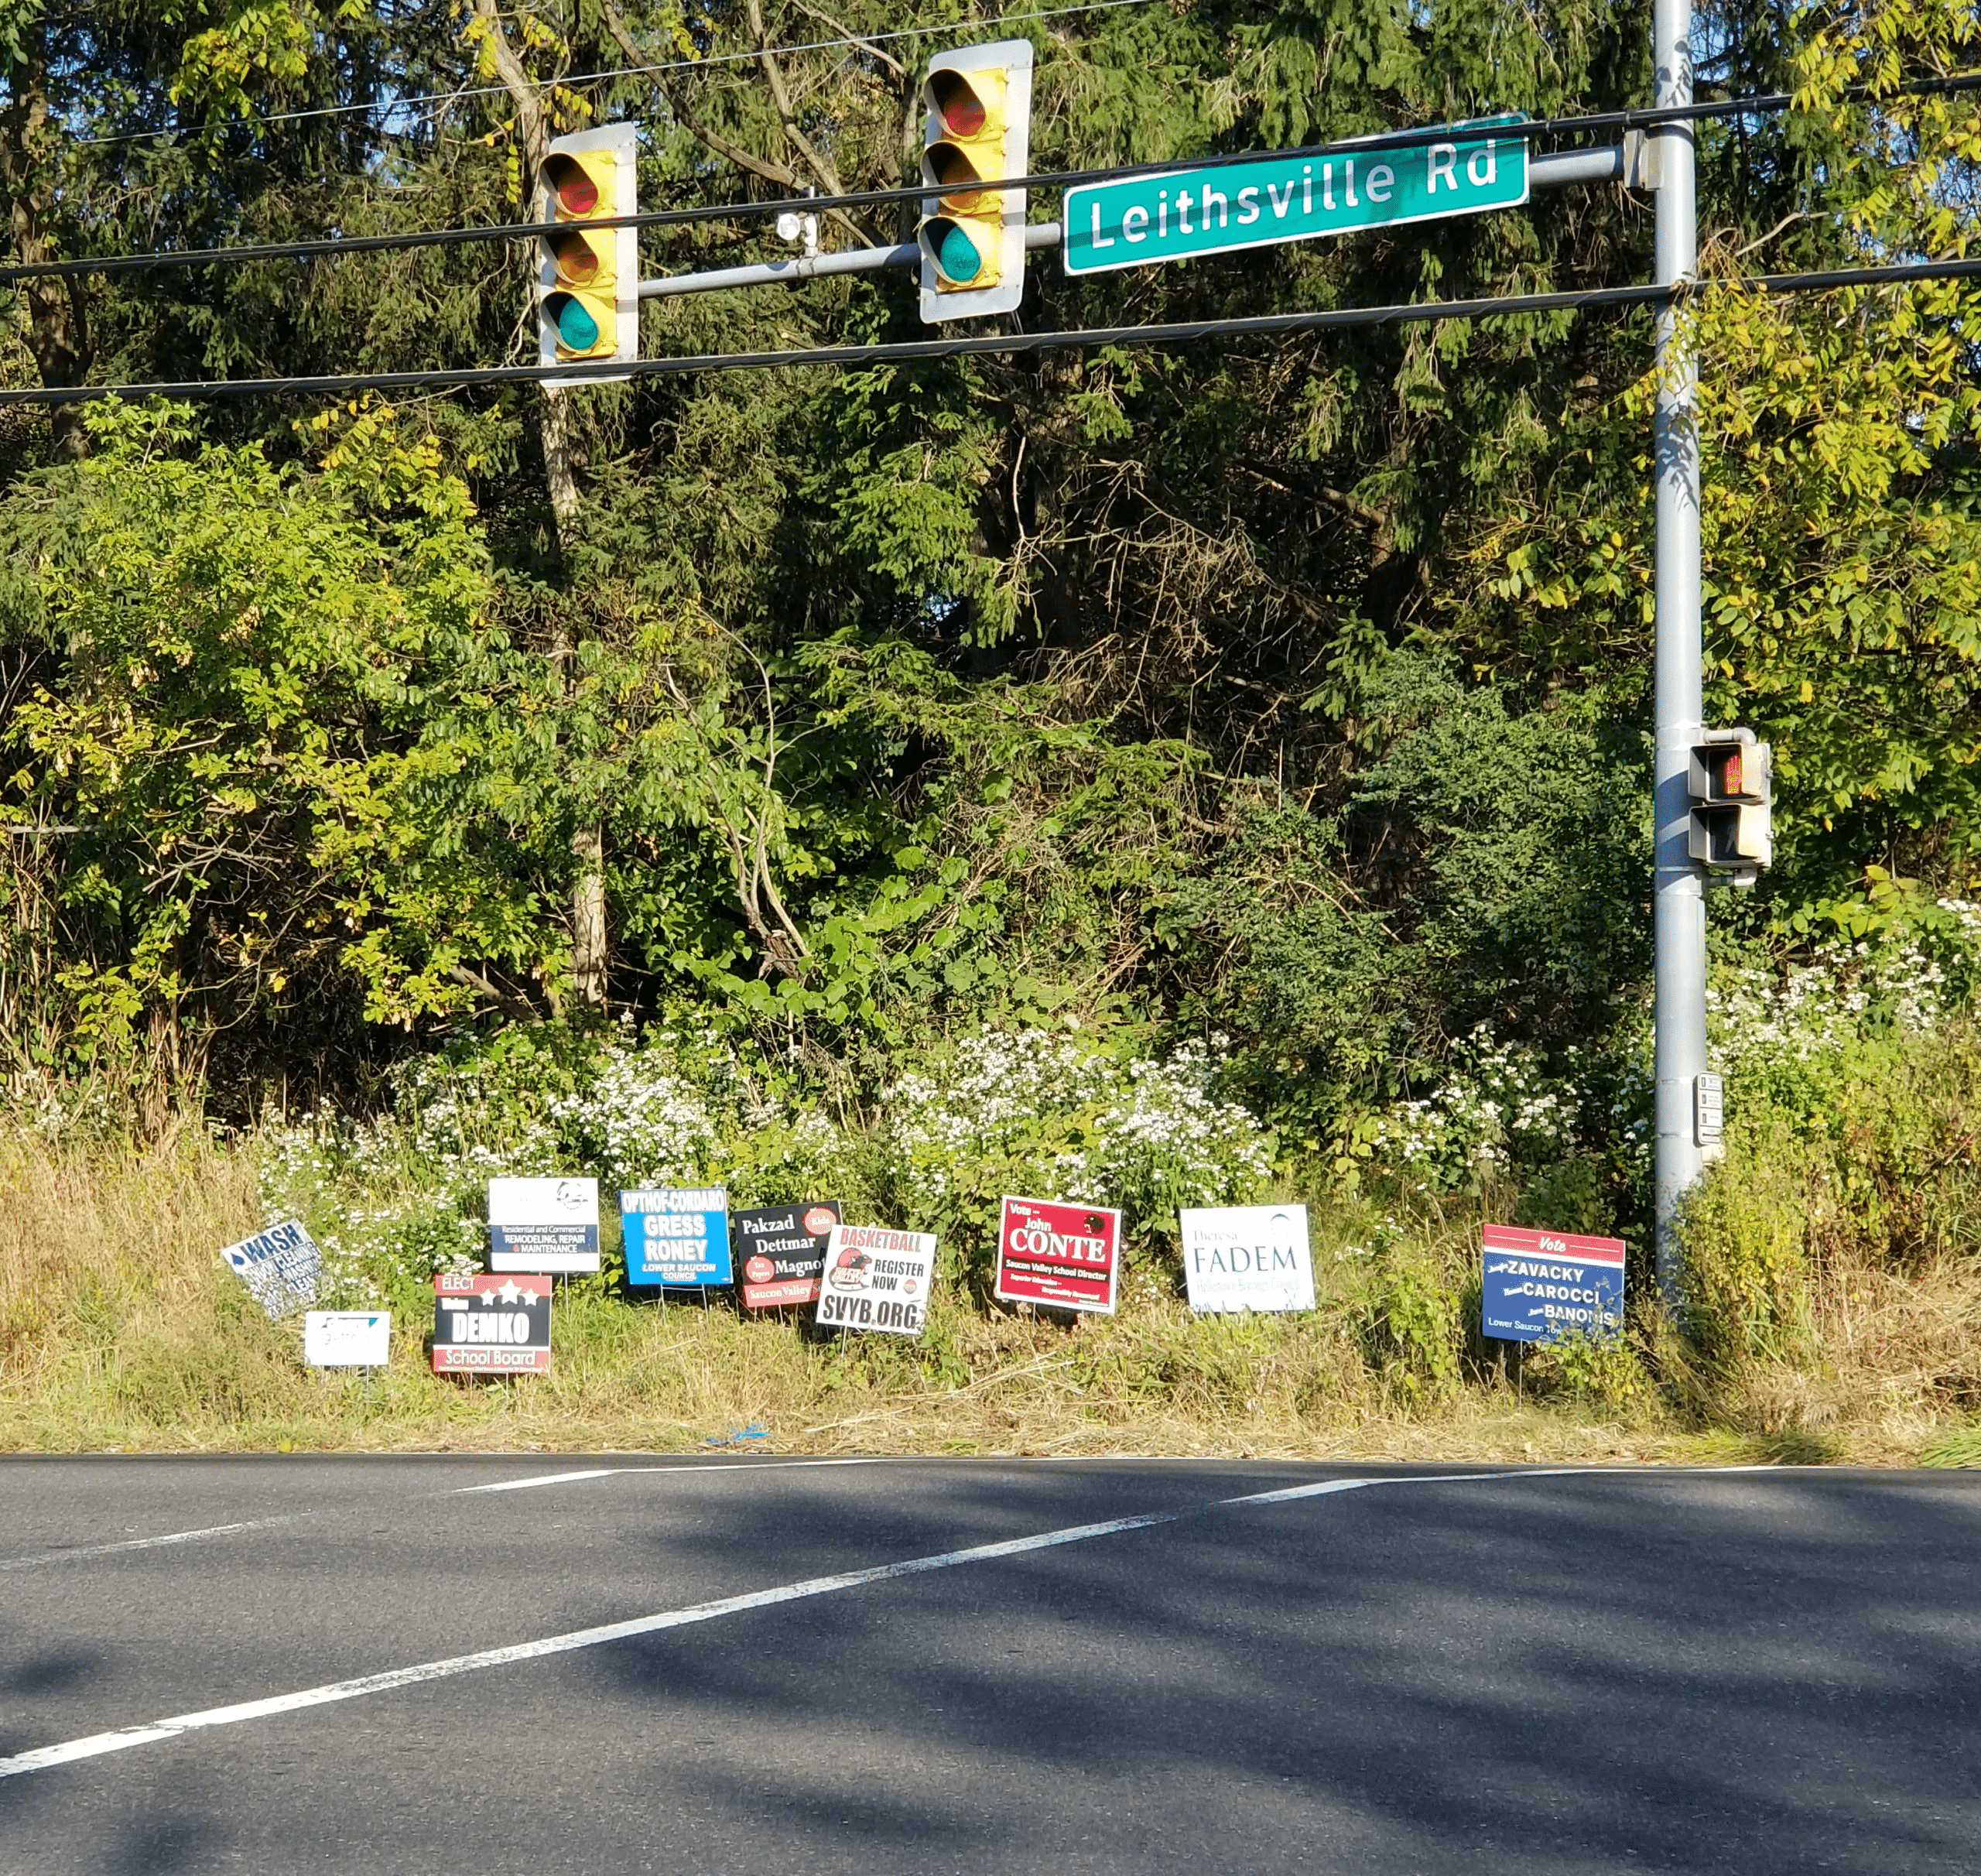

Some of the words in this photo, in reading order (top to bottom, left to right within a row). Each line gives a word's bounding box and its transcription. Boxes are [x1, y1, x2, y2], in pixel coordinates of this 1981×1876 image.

[1090, 163, 1394, 250] Leithsville
[1426, 138, 1498, 194] Rd
[622, 1189, 724, 1214] OPTHOF-CORDARO
[1010, 1203, 1032, 1216] Vote
[644, 1214, 706, 1237] GRESS
[742, 1214, 795, 1234] Pakzad
[1025, 1217, 1052, 1232] John
[238, 1224, 303, 1265] WASH
[505, 1234, 557, 1244] REMODELING,
[559, 1234, 586, 1244] REPAIR
[840, 1227, 921, 1252] BASKETBALL
[1010, 1227, 1106, 1263] CONTE
[1192, 1230, 1238, 1241] Theresa
[1539, 1236, 1566, 1252] Vote
[521, 1244, 578, 1253] MAINTENANCE
[644, 1238, 708, 1262] RONEY
[755, 1237, 816, 1254] Dettmar
[641, 1264, 676, 1272] LOWER
[677, 1263, 717, 1272] SAUCON
[874, 1258, 924, 1277] REGISTER
[1193, 1245, 1297, 1273] FADEM
[662, 1272, 696, 1281] COUNCIL
[1006, 1259, 1031, 1270] Saucon
[1032, 1262, 1052, 1275] Valley
[1053, 1265, 1077, 1277] School
[1077, 1270, 1107, 1281] Director
[1507, 1260, 1584, 1283] ZAVACKY
[442, 1277, 474, 1290] ELECT
[749, 1289, 782, 1299] Saucon
[782, 1285, 810, 1297] Valley
[871, 1275, 898, 1291] NOW
[1523, 1282, 1599, 1305] CAROCCI
[823, 1294, 919, 1329] SVYB.ORG
[452, 1313, 530, 1344] DEMKO
[1488, 1316, 1513, 1328] Lower
[1514, 1320, 1544, 1332] Saucon
[446, 1350, 491, 1364] School
[494, 1351, 535, 1365] Board
